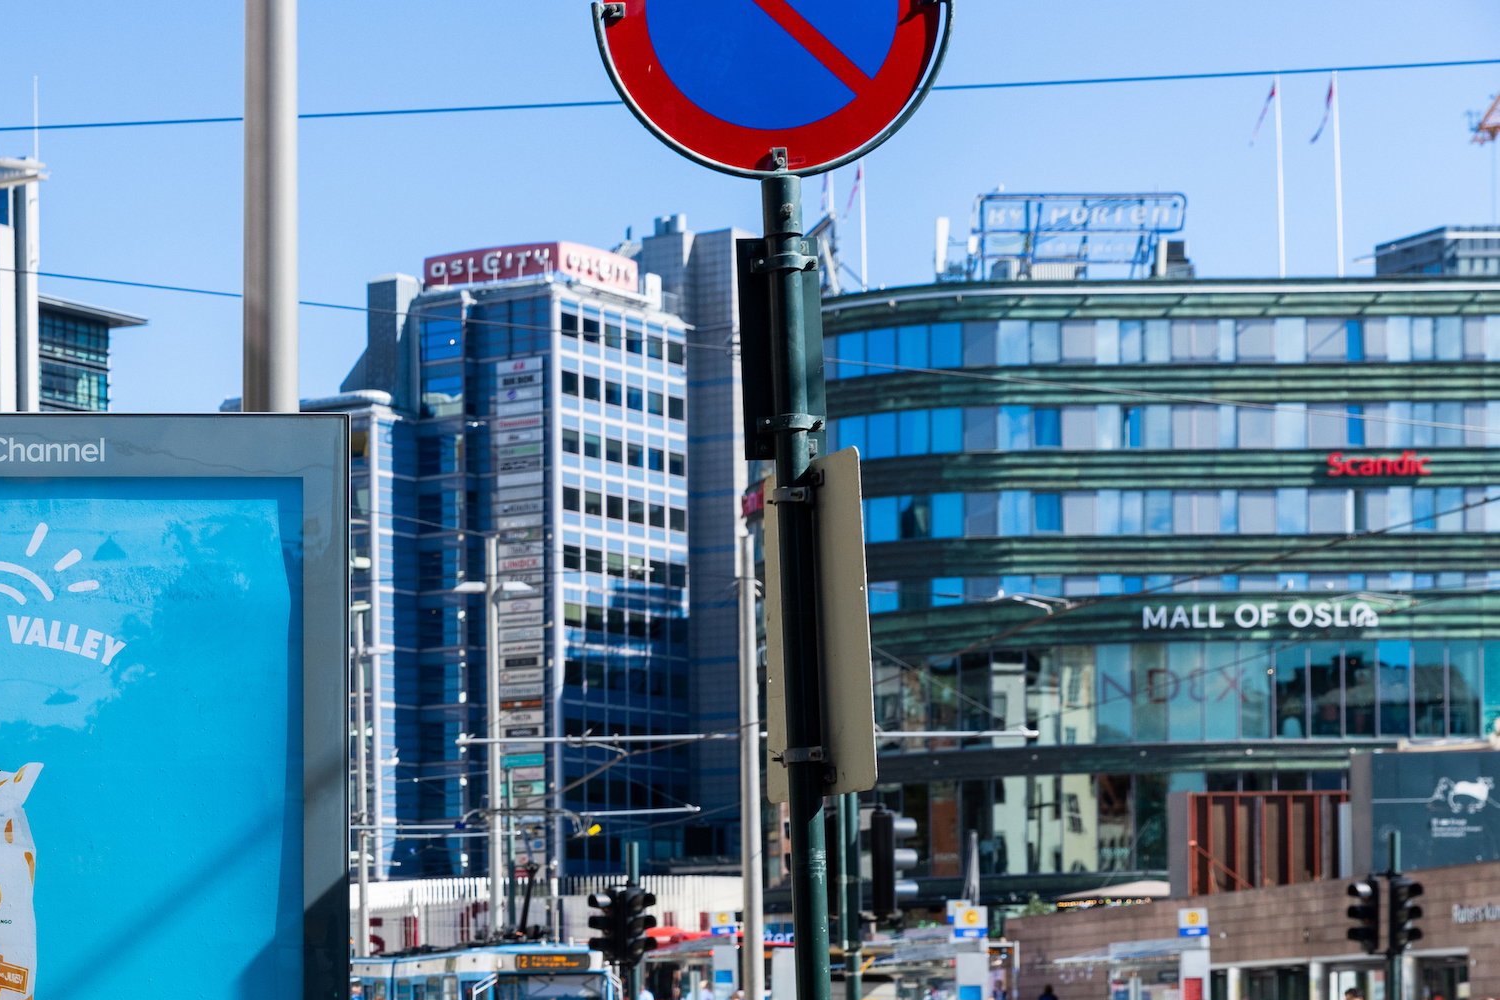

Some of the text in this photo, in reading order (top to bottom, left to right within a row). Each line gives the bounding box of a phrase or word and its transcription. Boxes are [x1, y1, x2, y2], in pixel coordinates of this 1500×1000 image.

[1327, 451, 1431, 476] Scandic
[1143, 604, 1225, 629] MALL
[1234, 603, 1279, 629] OF
[7, 615, 127, 666] VALLEY
